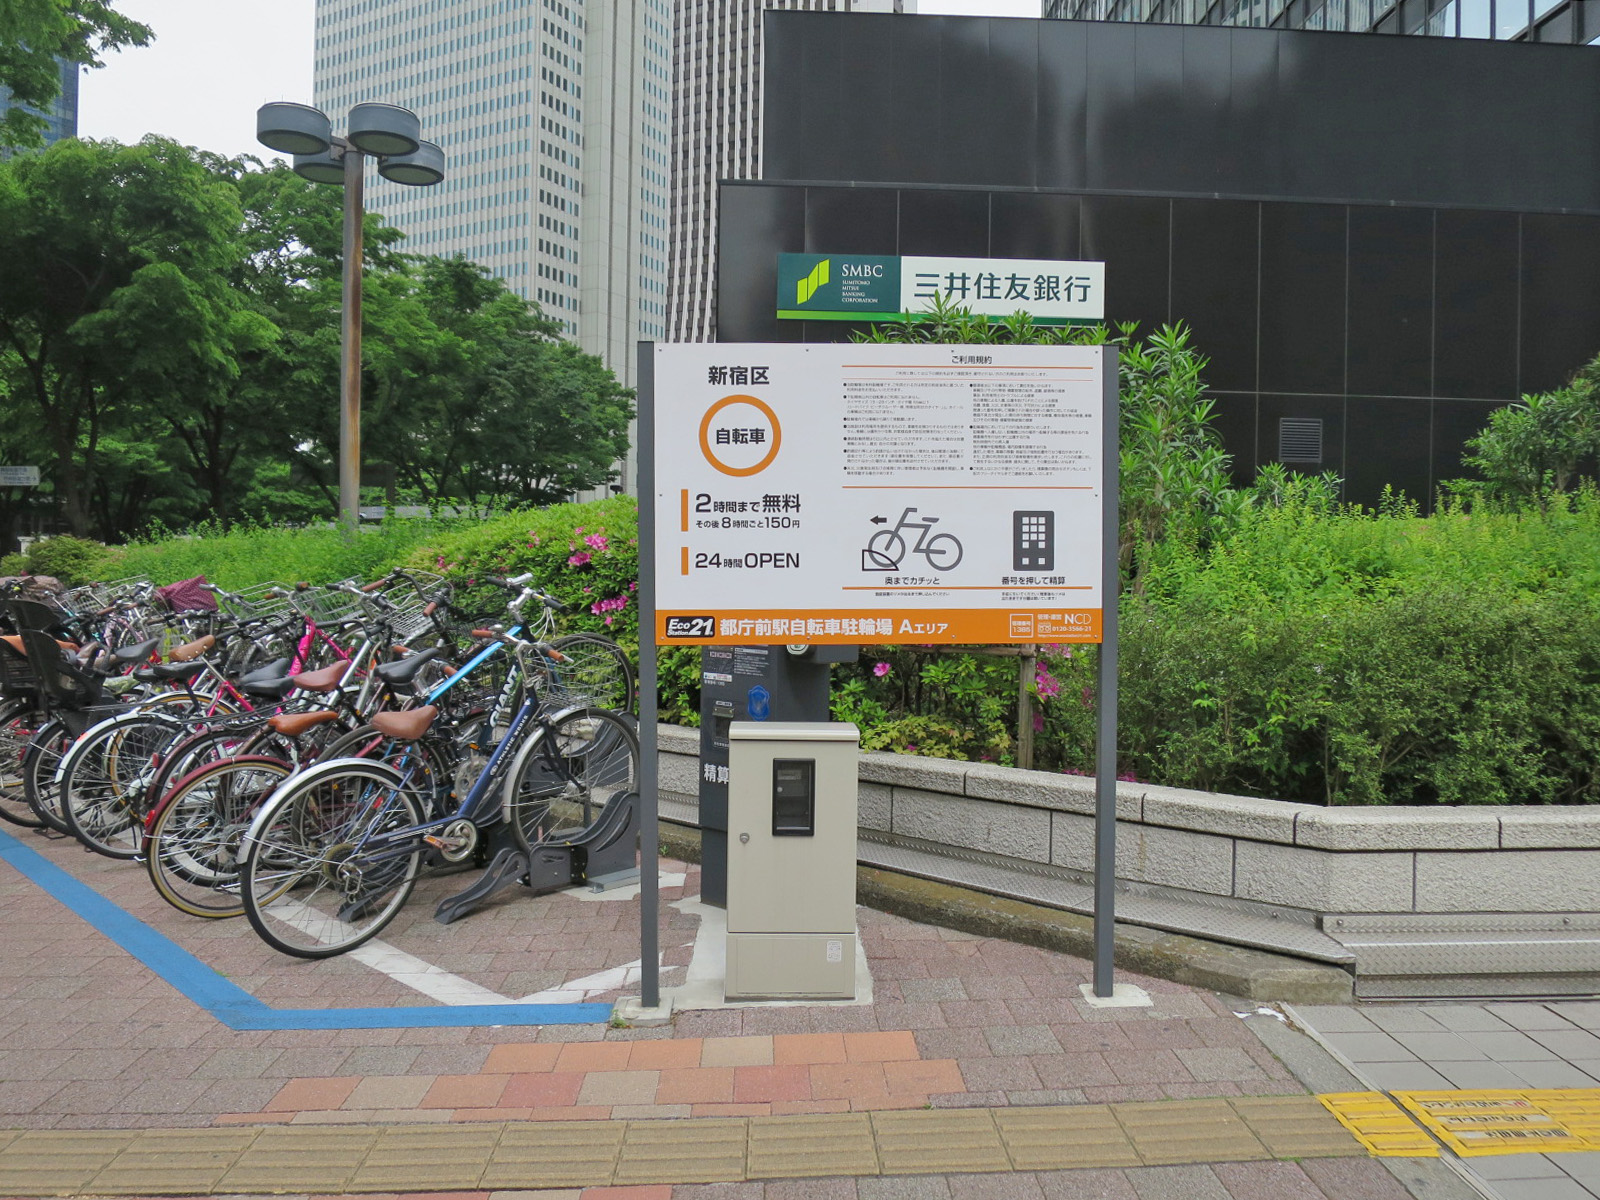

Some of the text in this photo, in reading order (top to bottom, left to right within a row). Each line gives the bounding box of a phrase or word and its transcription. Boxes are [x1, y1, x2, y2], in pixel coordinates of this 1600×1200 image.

[841, 263, 883, 278] SMBC
[914, 271, 1091, 303] 三井住友銀行
[951, 355, 993, 365] ご利用規約
[708, 365, 770, 386] 新宿区
[715, 427, 766, 445] 自転車
[695, 493, 801, 513] 2時間まで無料
[695, 552, 800, 569] 24時間OPEN
[884, 576, 941, 586] 奥までカチッと
[1001, 576, 1066, 586] 番号を押して精算
[668, 618, 713, 636] Eco 21
[720, 618, 949, 637] 都庁前駅自転車駐輪場 Aエリア
[1064, 613, 1092, 625] NCD
[489, 664, 517, 728] GIANT
[496, 736, 515, 766] ATHLETIC
